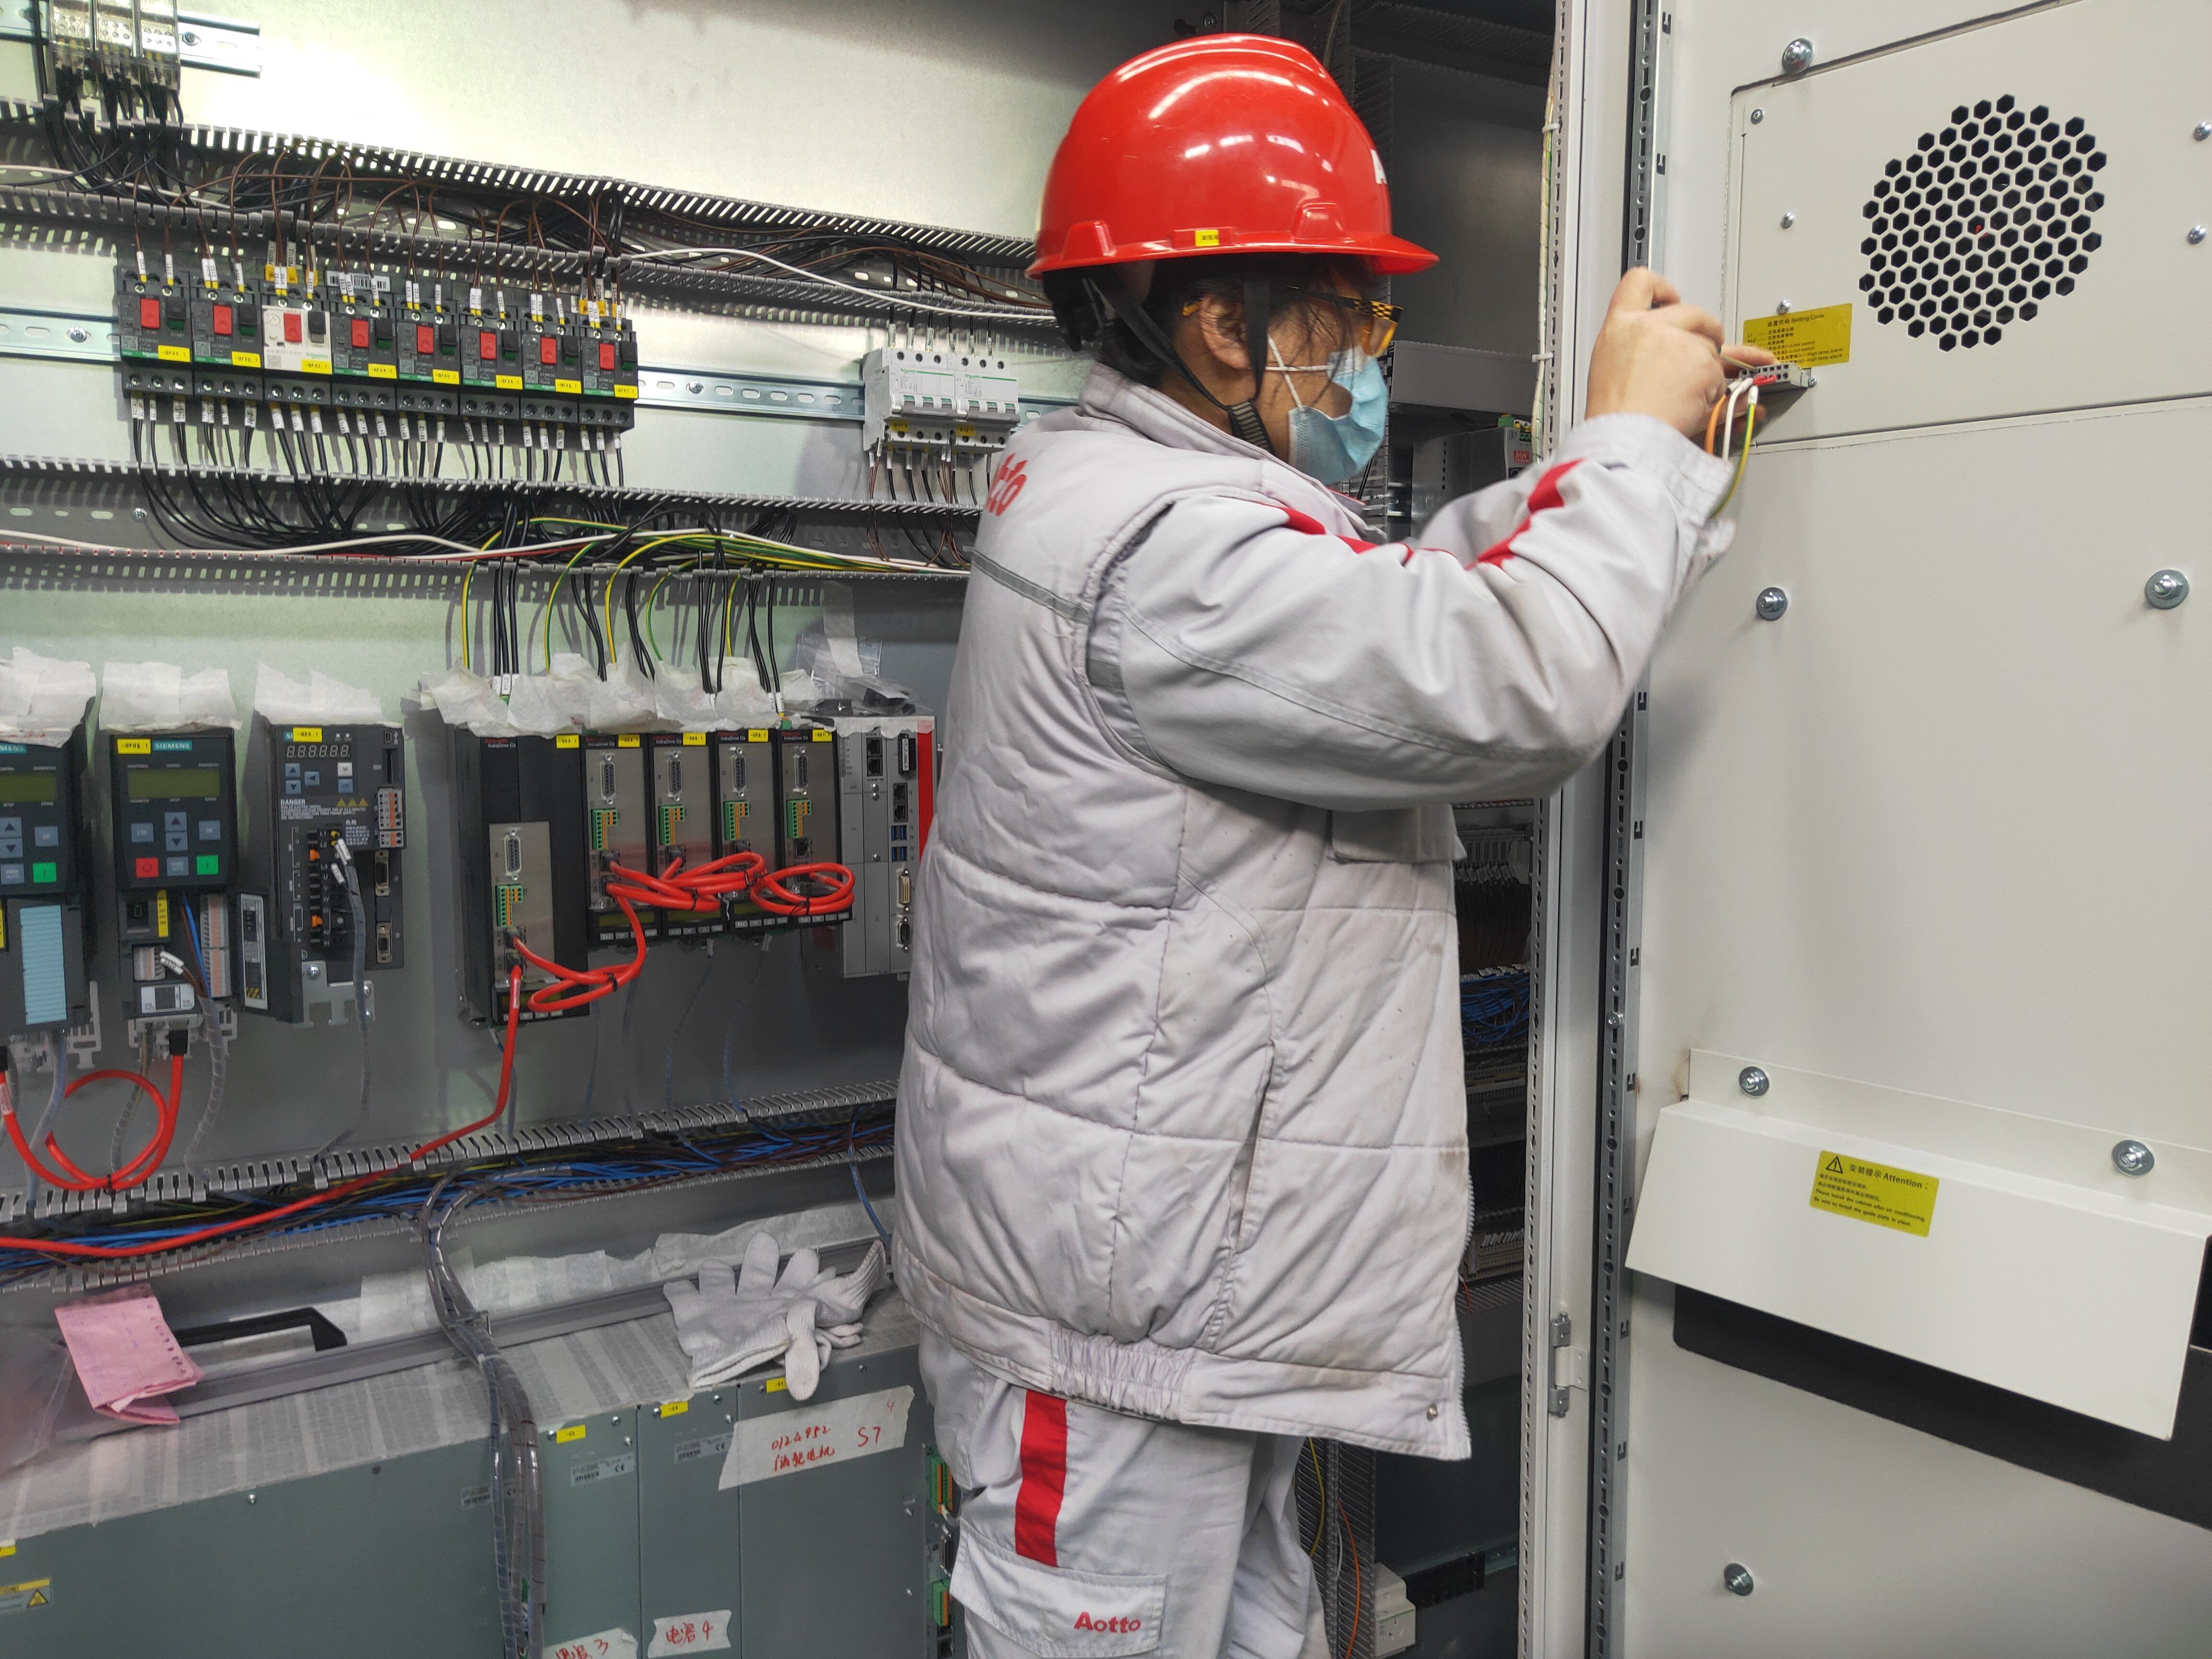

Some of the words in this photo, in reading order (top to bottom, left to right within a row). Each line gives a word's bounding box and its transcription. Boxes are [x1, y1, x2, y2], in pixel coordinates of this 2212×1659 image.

[155, 742, 191, 750] SIEMENS
[1849, 1164, 1882, 1178] 安装提示
[1073, 1611, 1142, 1634] Aotto
